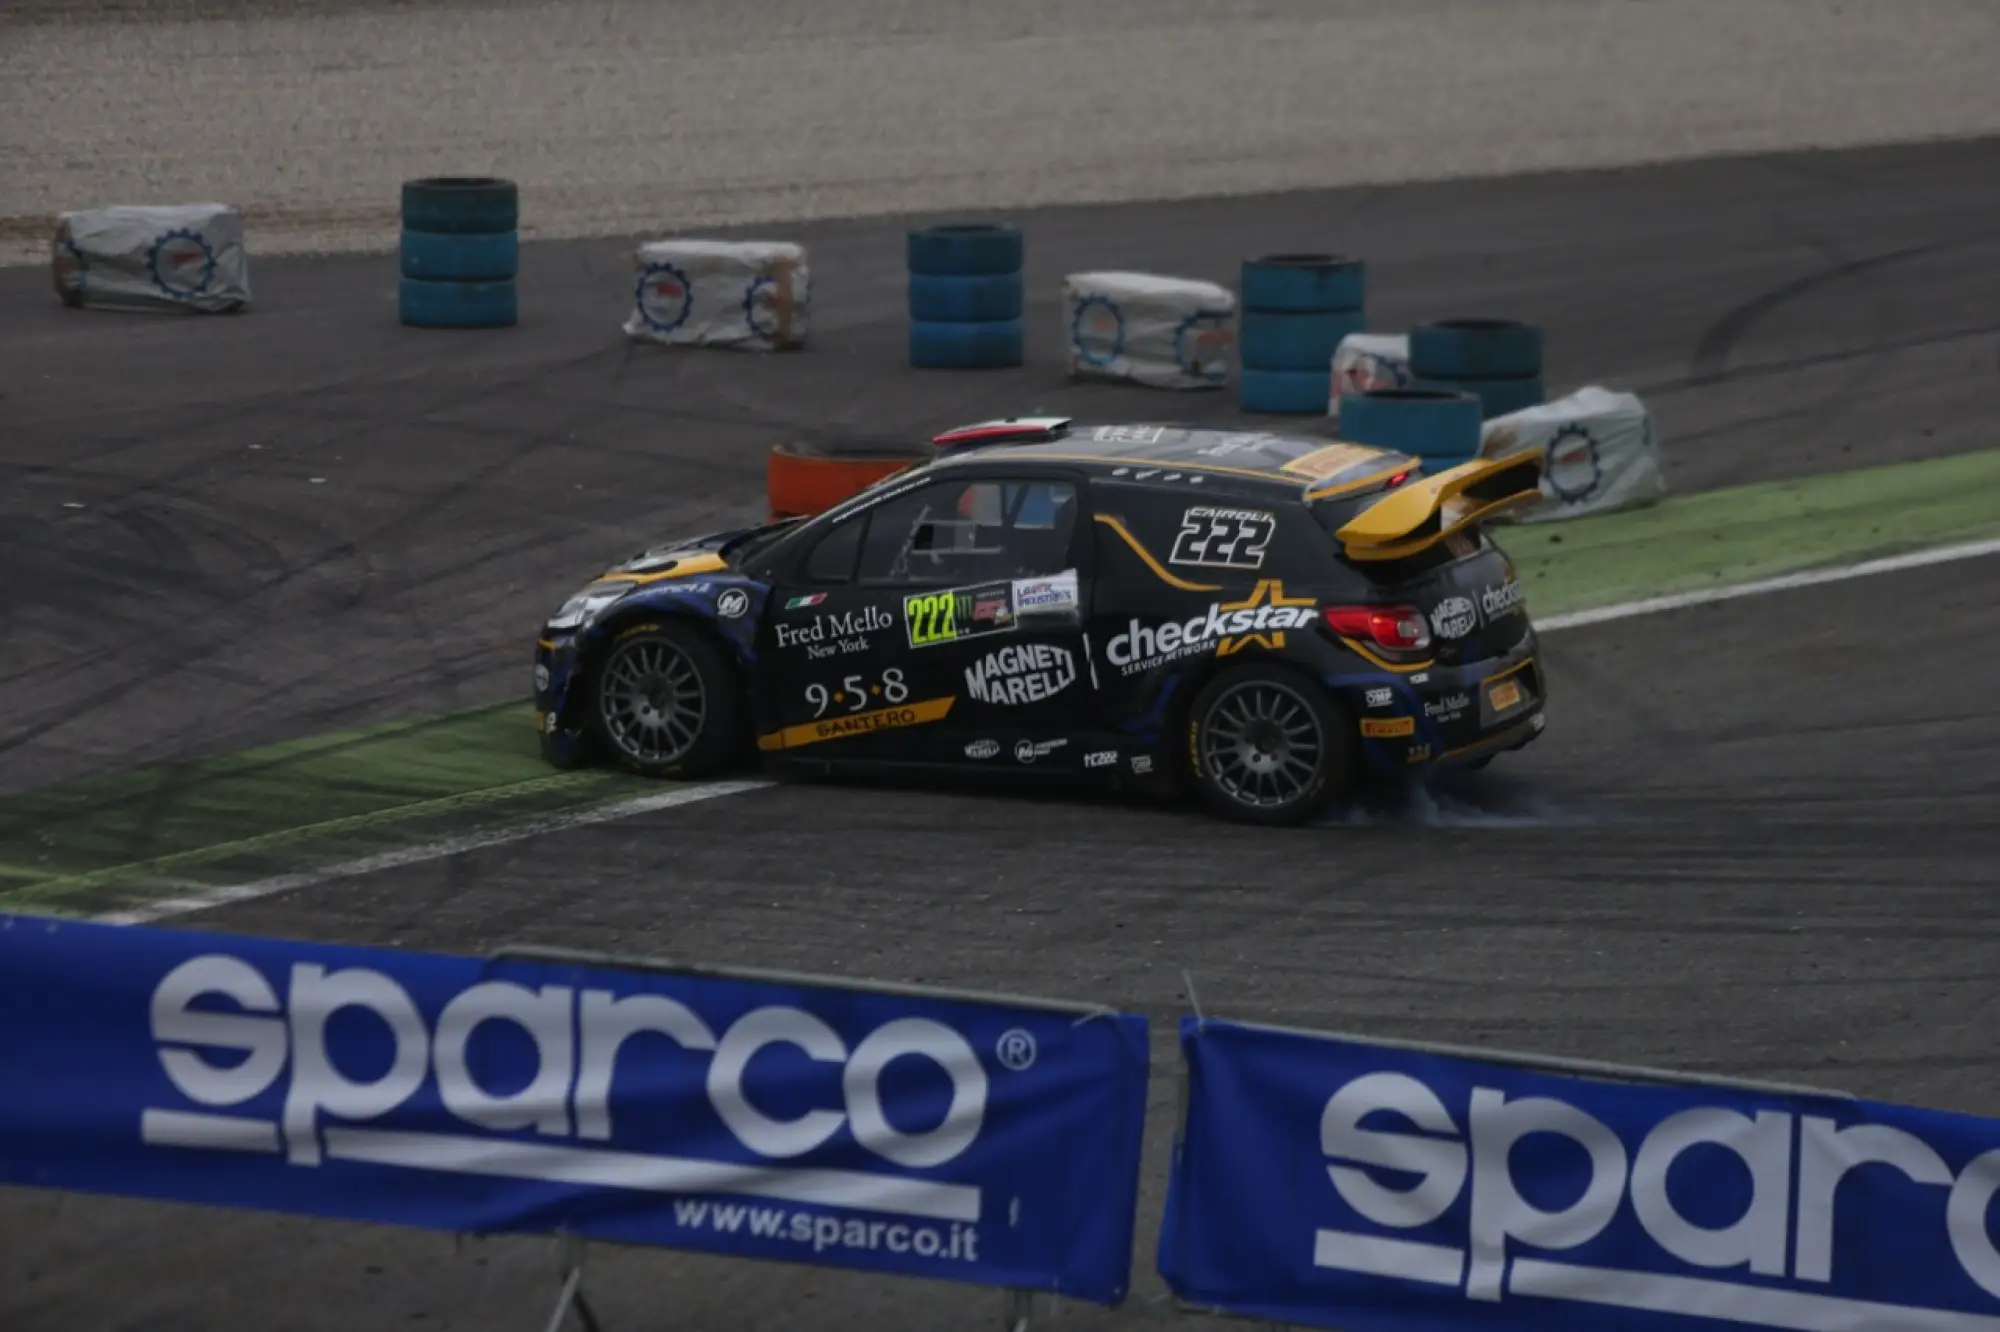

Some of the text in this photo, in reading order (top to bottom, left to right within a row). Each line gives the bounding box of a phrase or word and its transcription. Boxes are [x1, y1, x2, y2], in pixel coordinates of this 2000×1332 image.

[1168, 510, 1276, 569] 222
[1189, 507, 1274, 523] CAIROLI
[775, 604, 893, 648] Fred Mello
[907, 591, 957, 645] 222
[1105, 602, 1320, 667] checkstar
[806, 636, 870, 660] New York
[151, 954, 989, 1166] sparco
[673, 1199, 979, 1262] www.sparco.it
